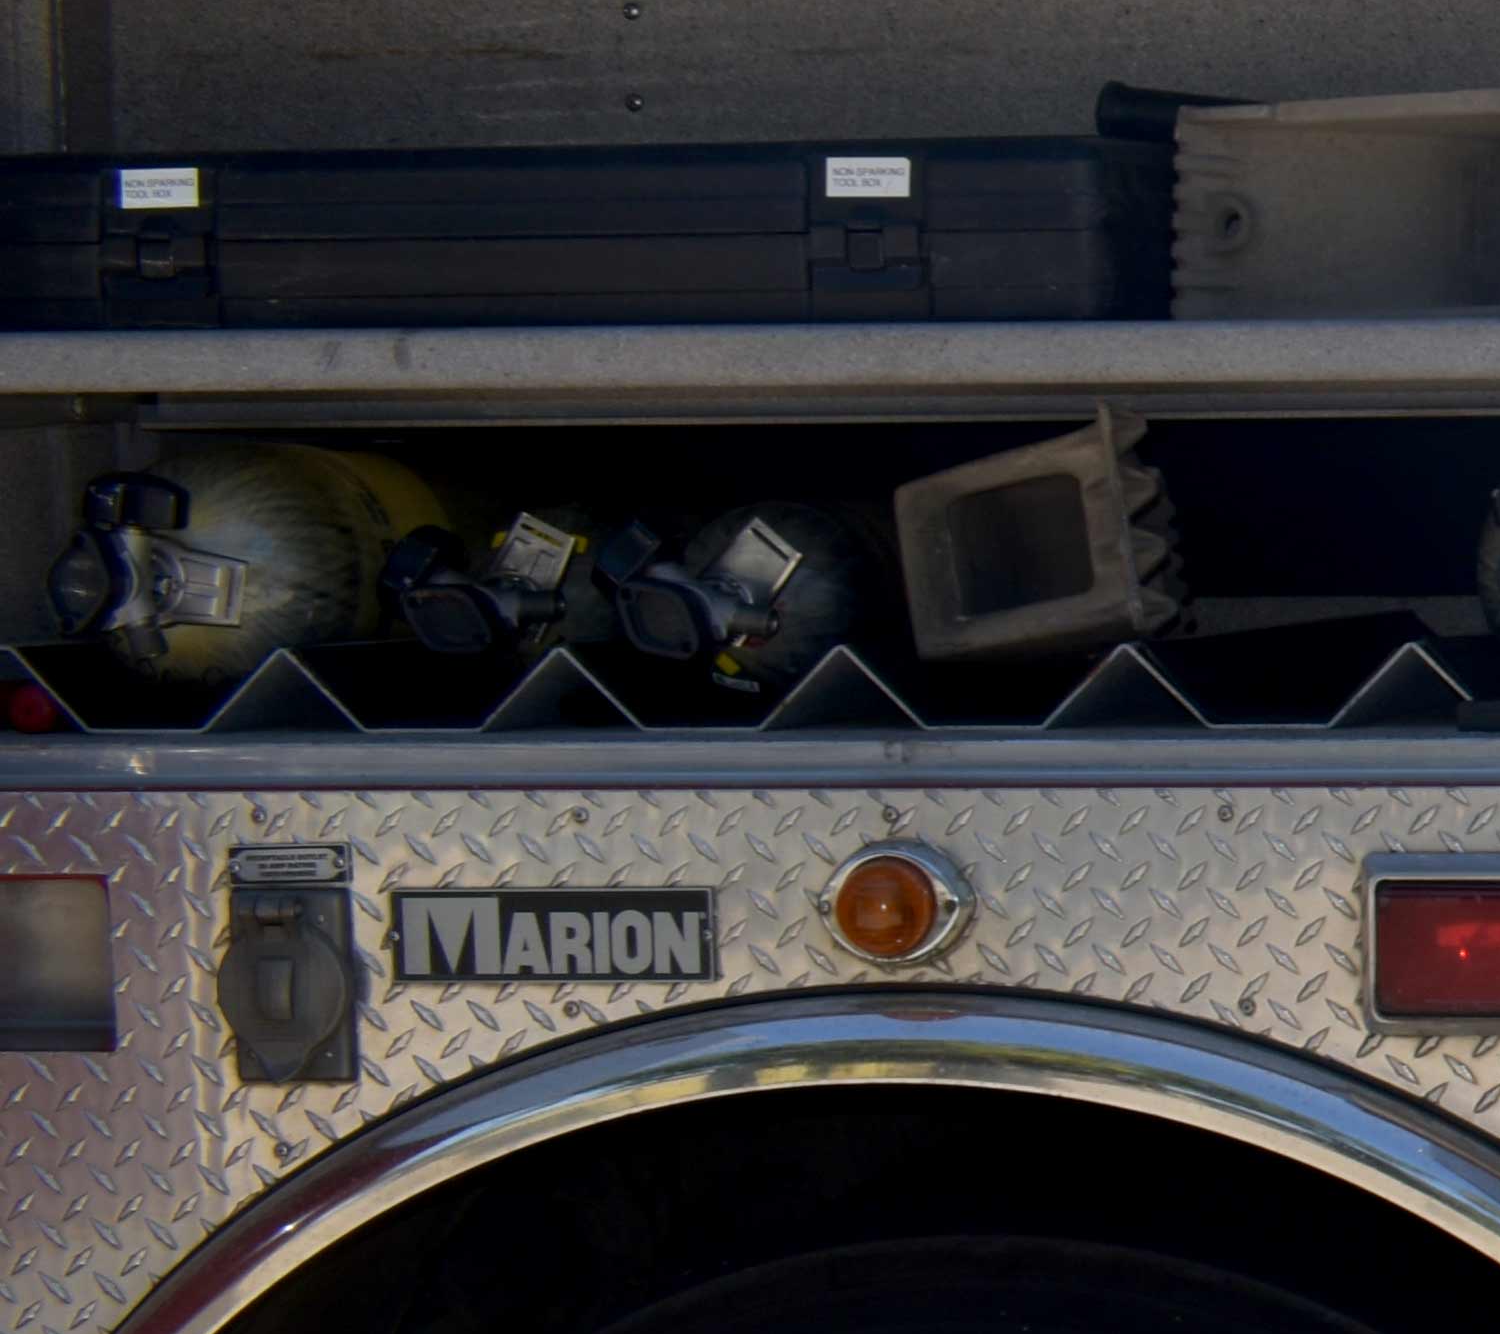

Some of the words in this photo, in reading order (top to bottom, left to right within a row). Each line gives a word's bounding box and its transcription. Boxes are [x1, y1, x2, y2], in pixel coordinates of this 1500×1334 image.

[832, 178, 858, 187] TOOL
[124, 190, 149, 199] TOOL
[401, 896, 702, 975] MARION
